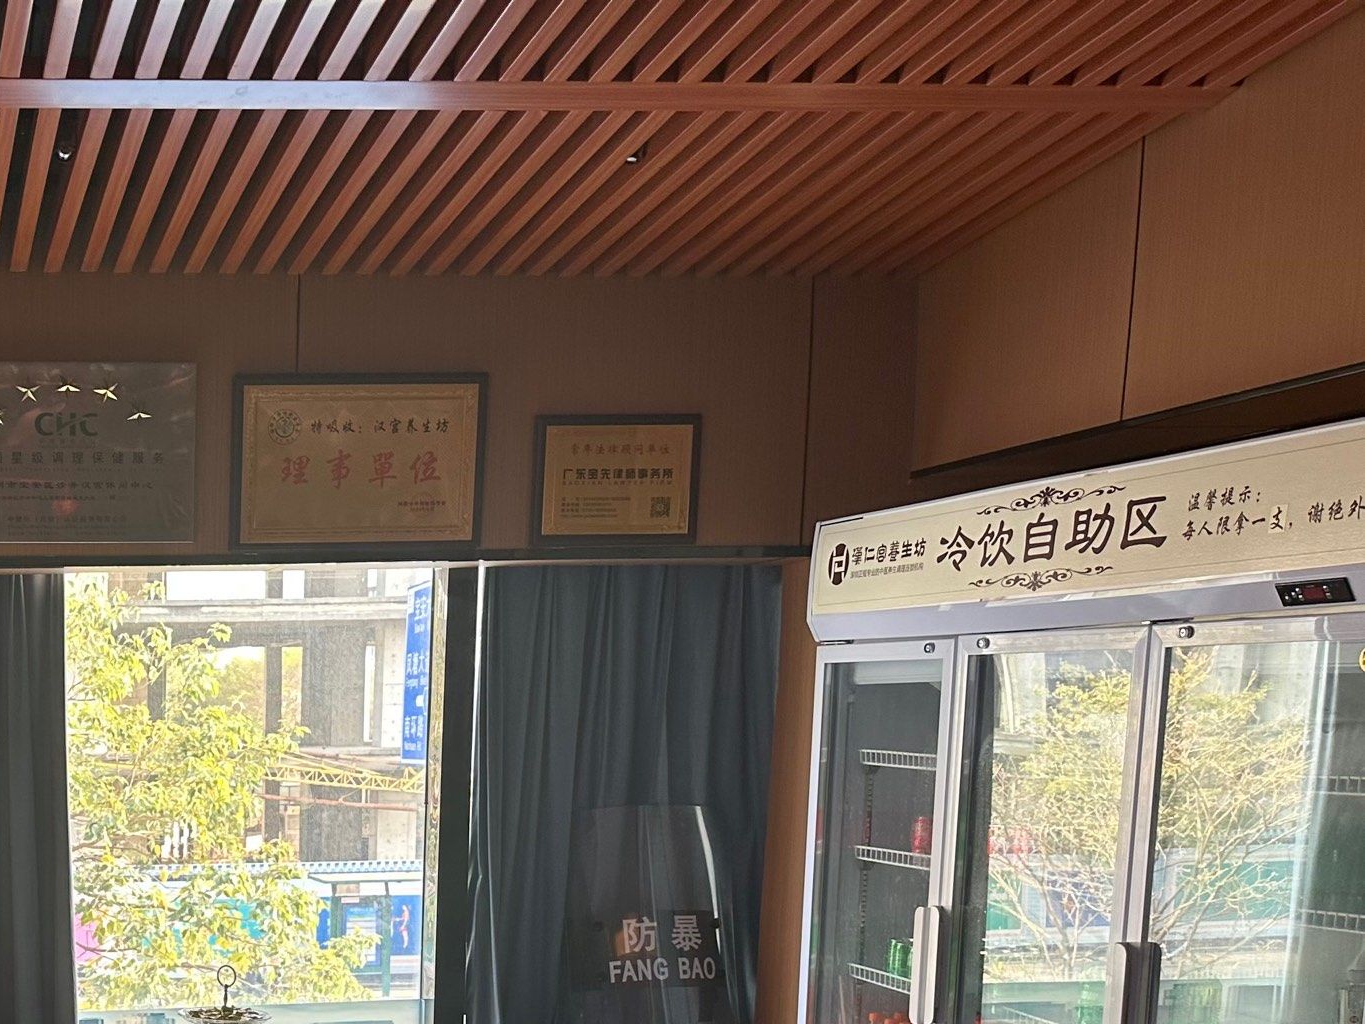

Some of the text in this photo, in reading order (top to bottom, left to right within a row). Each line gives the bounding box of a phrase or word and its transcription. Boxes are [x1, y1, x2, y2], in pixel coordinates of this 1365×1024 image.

[34, 412, 99, 437] CHC
[937, 496, 1168, 572] 冷饮自助区
[622, 914, 702, 954] 防暴
[608, 957, 716, 984] FANG BAO
